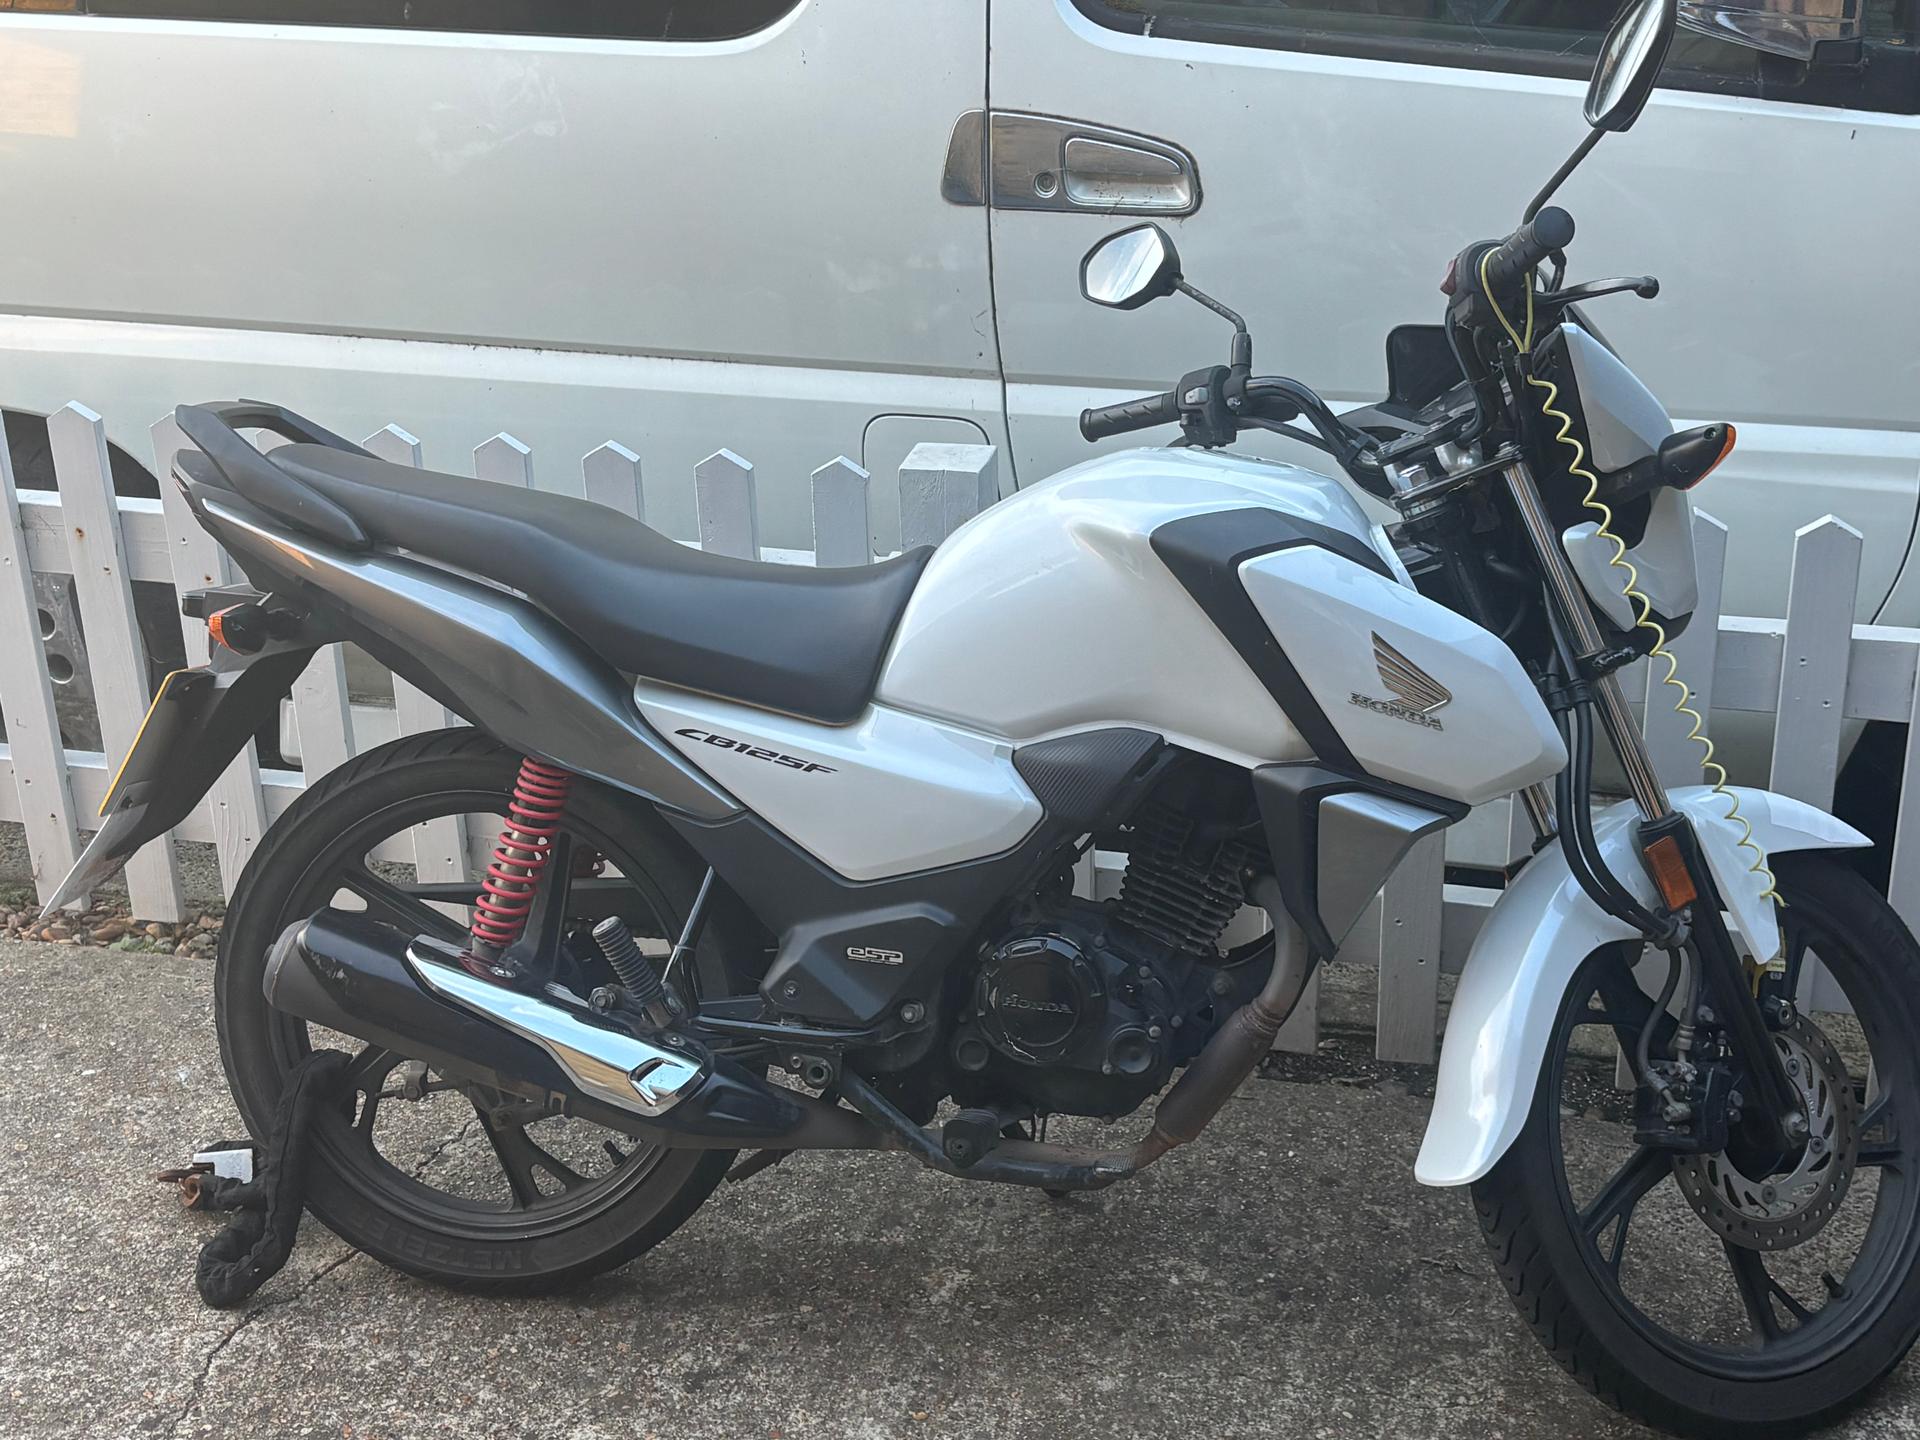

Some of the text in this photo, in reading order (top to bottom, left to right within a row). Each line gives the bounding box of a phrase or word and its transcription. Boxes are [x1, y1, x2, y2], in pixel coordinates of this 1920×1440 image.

[1348, 692, 1444, 731] HONDA
[674, 728, 839, 773] CB125F
[1002, 993, 1073, 1014] HONDA
